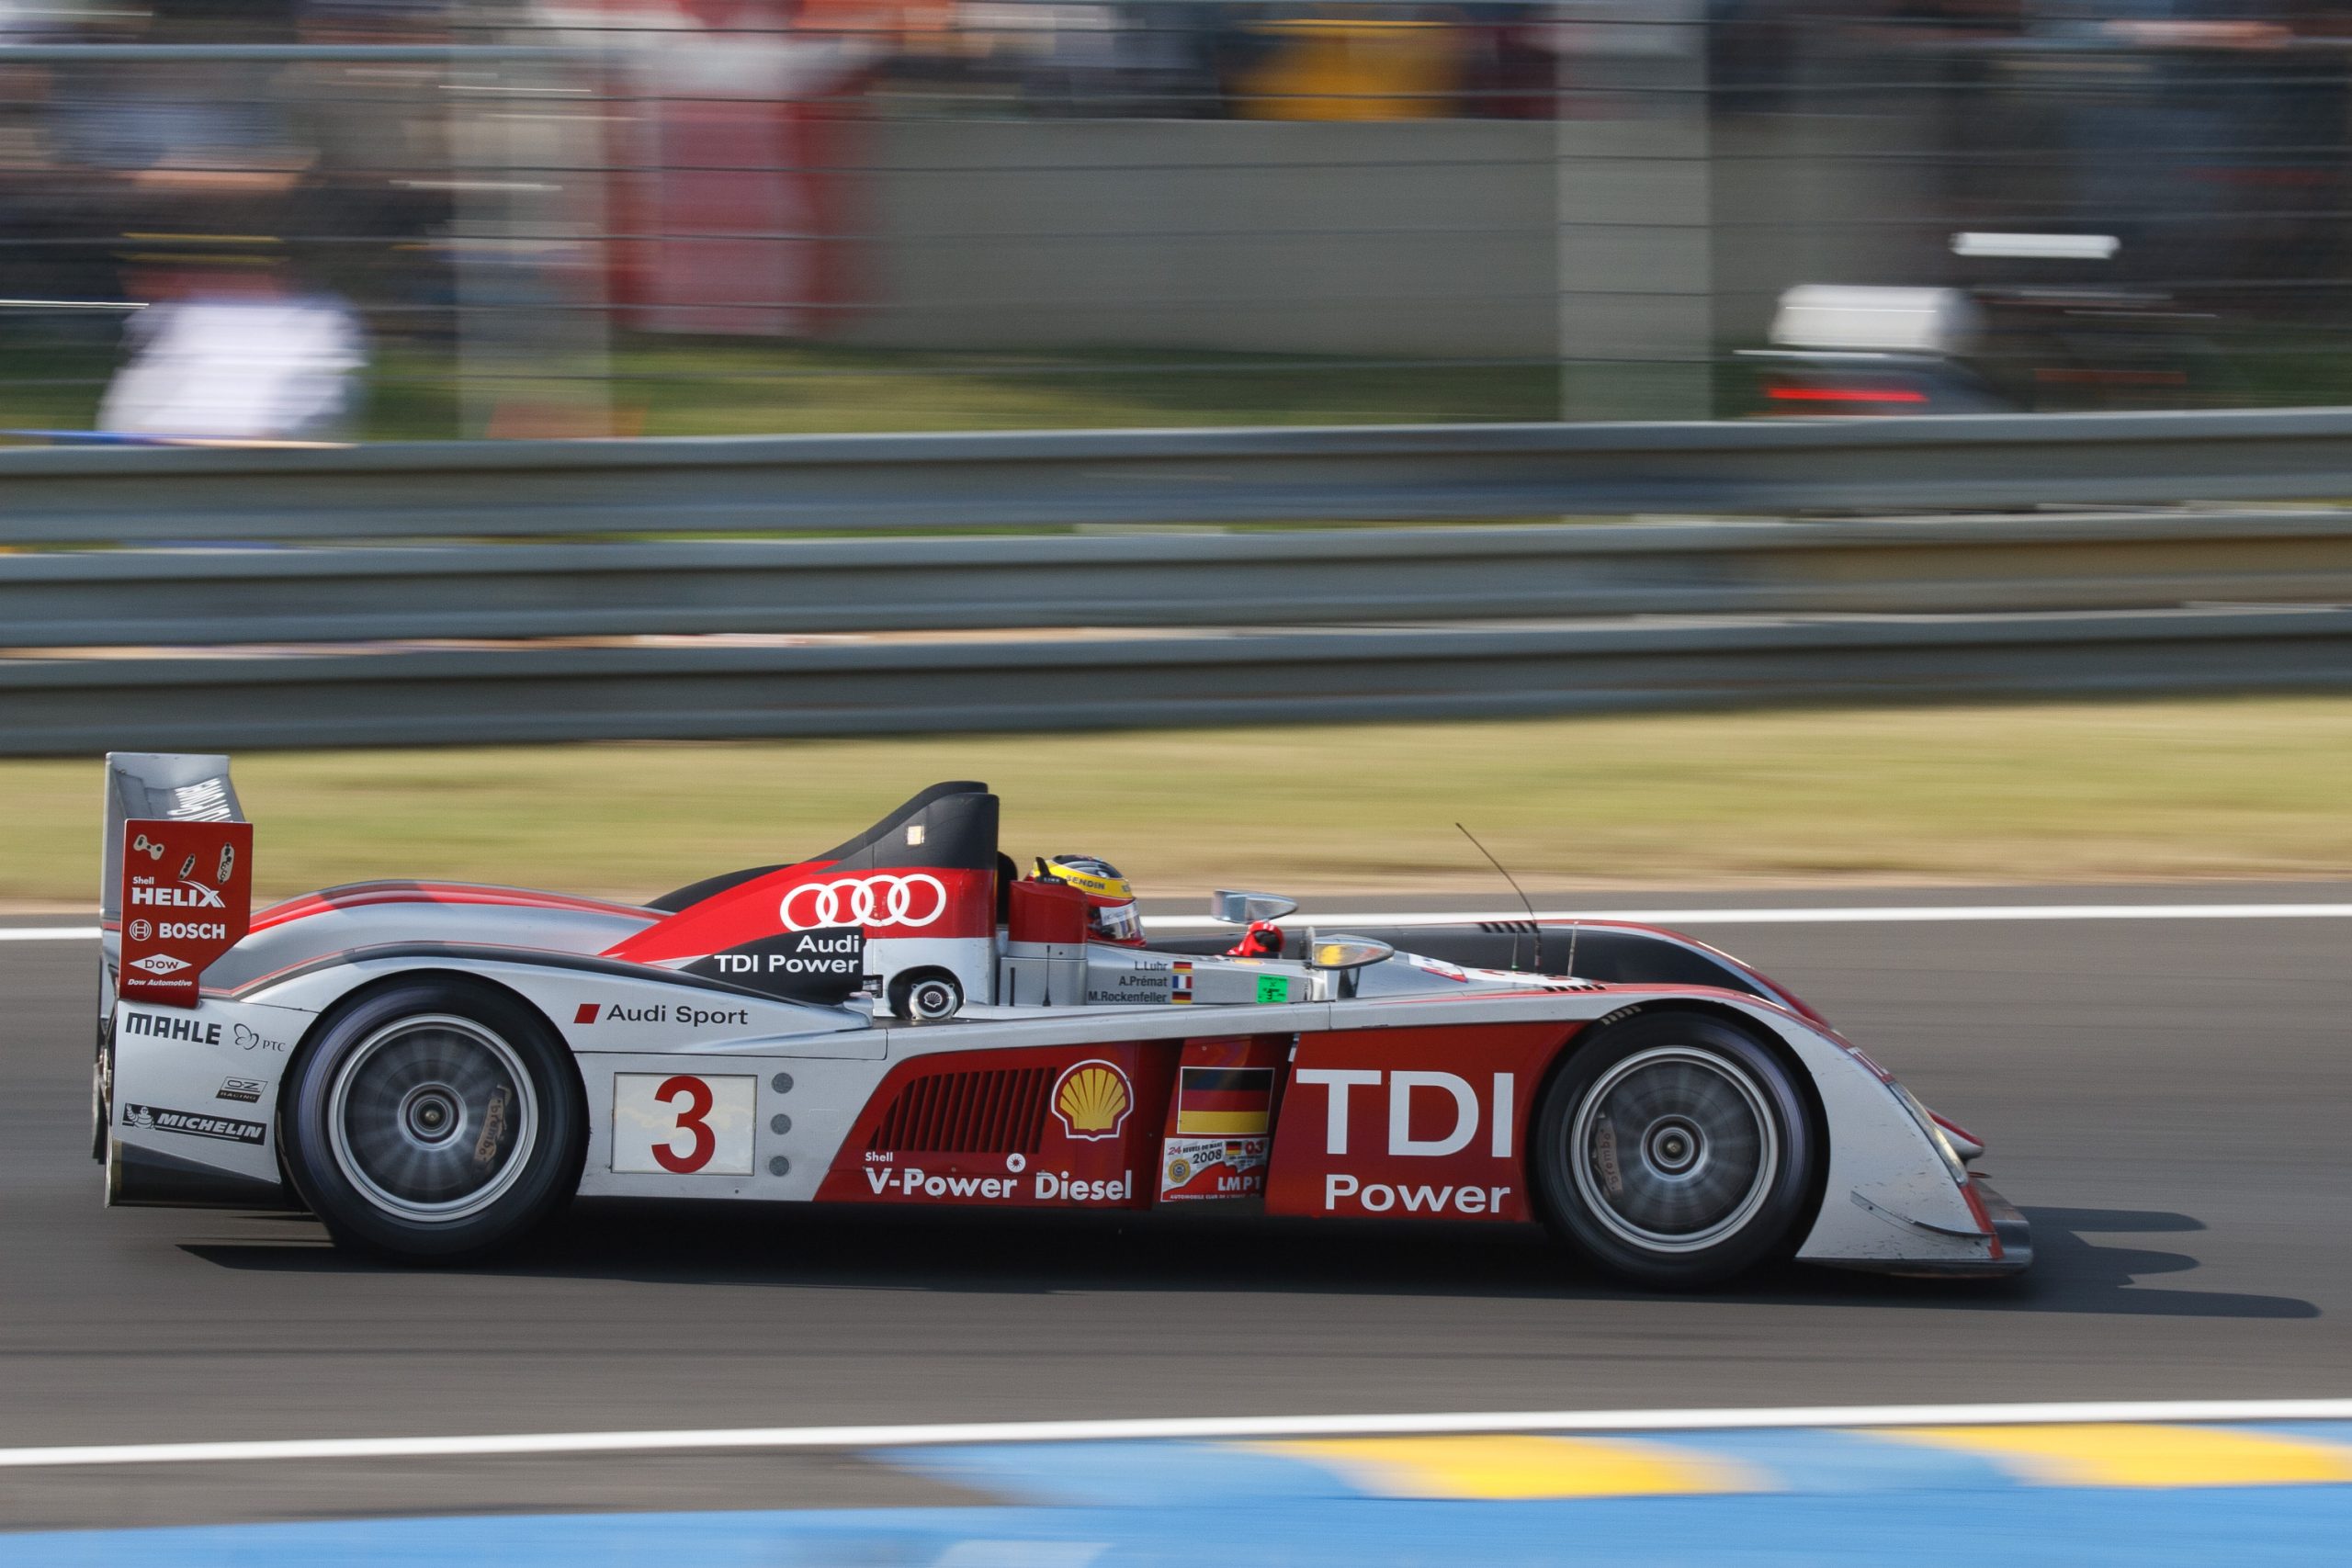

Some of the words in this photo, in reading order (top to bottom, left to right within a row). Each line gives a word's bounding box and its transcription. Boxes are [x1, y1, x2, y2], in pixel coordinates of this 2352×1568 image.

[132, 875, 155, 885] Shell
[131, 882, 226, 908] HELIX
[159, 922, 226, 940] BOSCH
[796, 935, 860, 953] Audi
[714, 954, 759, 973] TDI
[769, 955, 859, 974] Power
[1135, 961, 1168, 971] L.Luhr
[1118, 976, 1168, 987] A.Prémat
[1088, 991, 1167, 1002] M.Rockenfeller
[606, 1004, 666, 1022] Audi
[675, 1006, 749, 1027] Sport
[125, 1011, 222, 1045] MAHLE
[262, 1039, 286, 1053] PTC
[220, 1091, 256, 1100] RACING
[1296, 1068, 1514, 1157] TDI
[157, 1113, 263, 1138] MICHELIN
[479, 1105, 502, 1156] brembo
[650, 1075, 716, 1175] 3
[865, 1152, 893, 1162] Shell
[1168, 1145, 1182, 1156] 24
[1193, 1149, 1222, 1164] 2008
[1245, 1141, 1265, 1155] 03
[1601, 1133, 1618, 1184] brembo
[865, 1168, 1017, 1199] V-Power
[1035, 1169, 1132, 1201] Diesel
[1217, 1177, 1261, 1191] LMP1
[1325, 1174, 1510, 1213] Power
